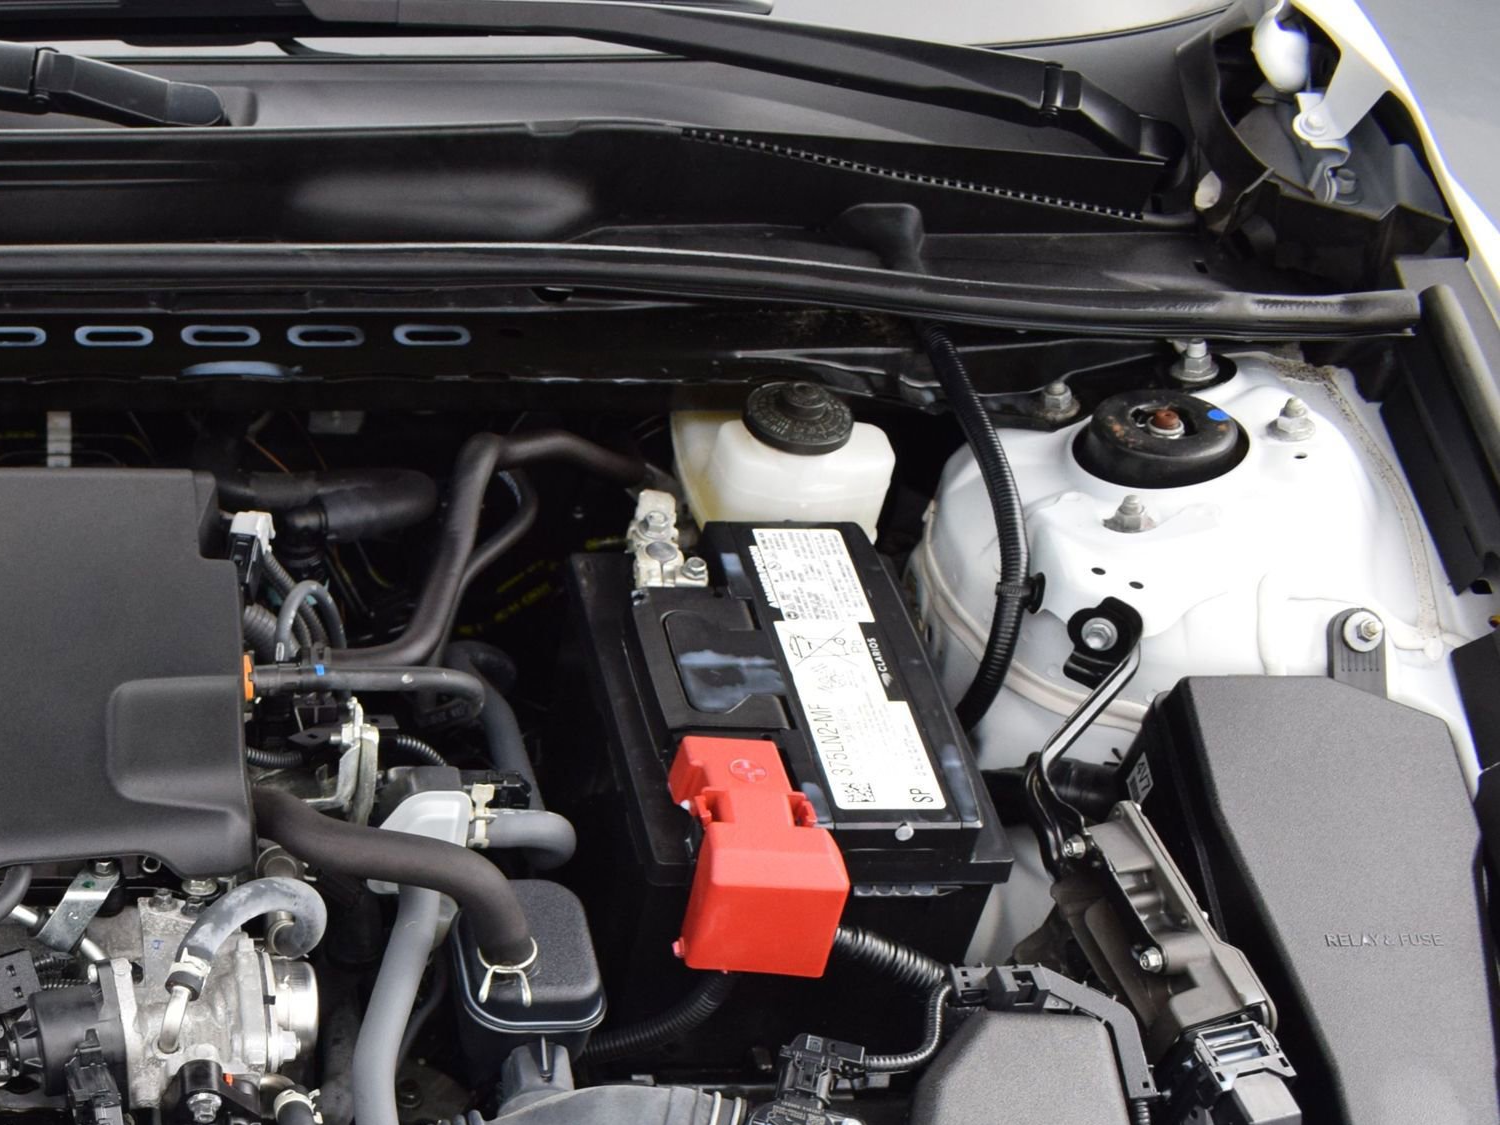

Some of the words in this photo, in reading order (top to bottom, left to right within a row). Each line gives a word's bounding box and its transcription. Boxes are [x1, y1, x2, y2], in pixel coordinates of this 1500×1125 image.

[866, 637, 888, 673] CLARIOS
[808, 703, 854, 776] 375LN2-MF
[909, 787, 934, 803] SP
[1324, 933, 1378, 947] RELAY
[1399, 933, 1445, 947] FUSE
